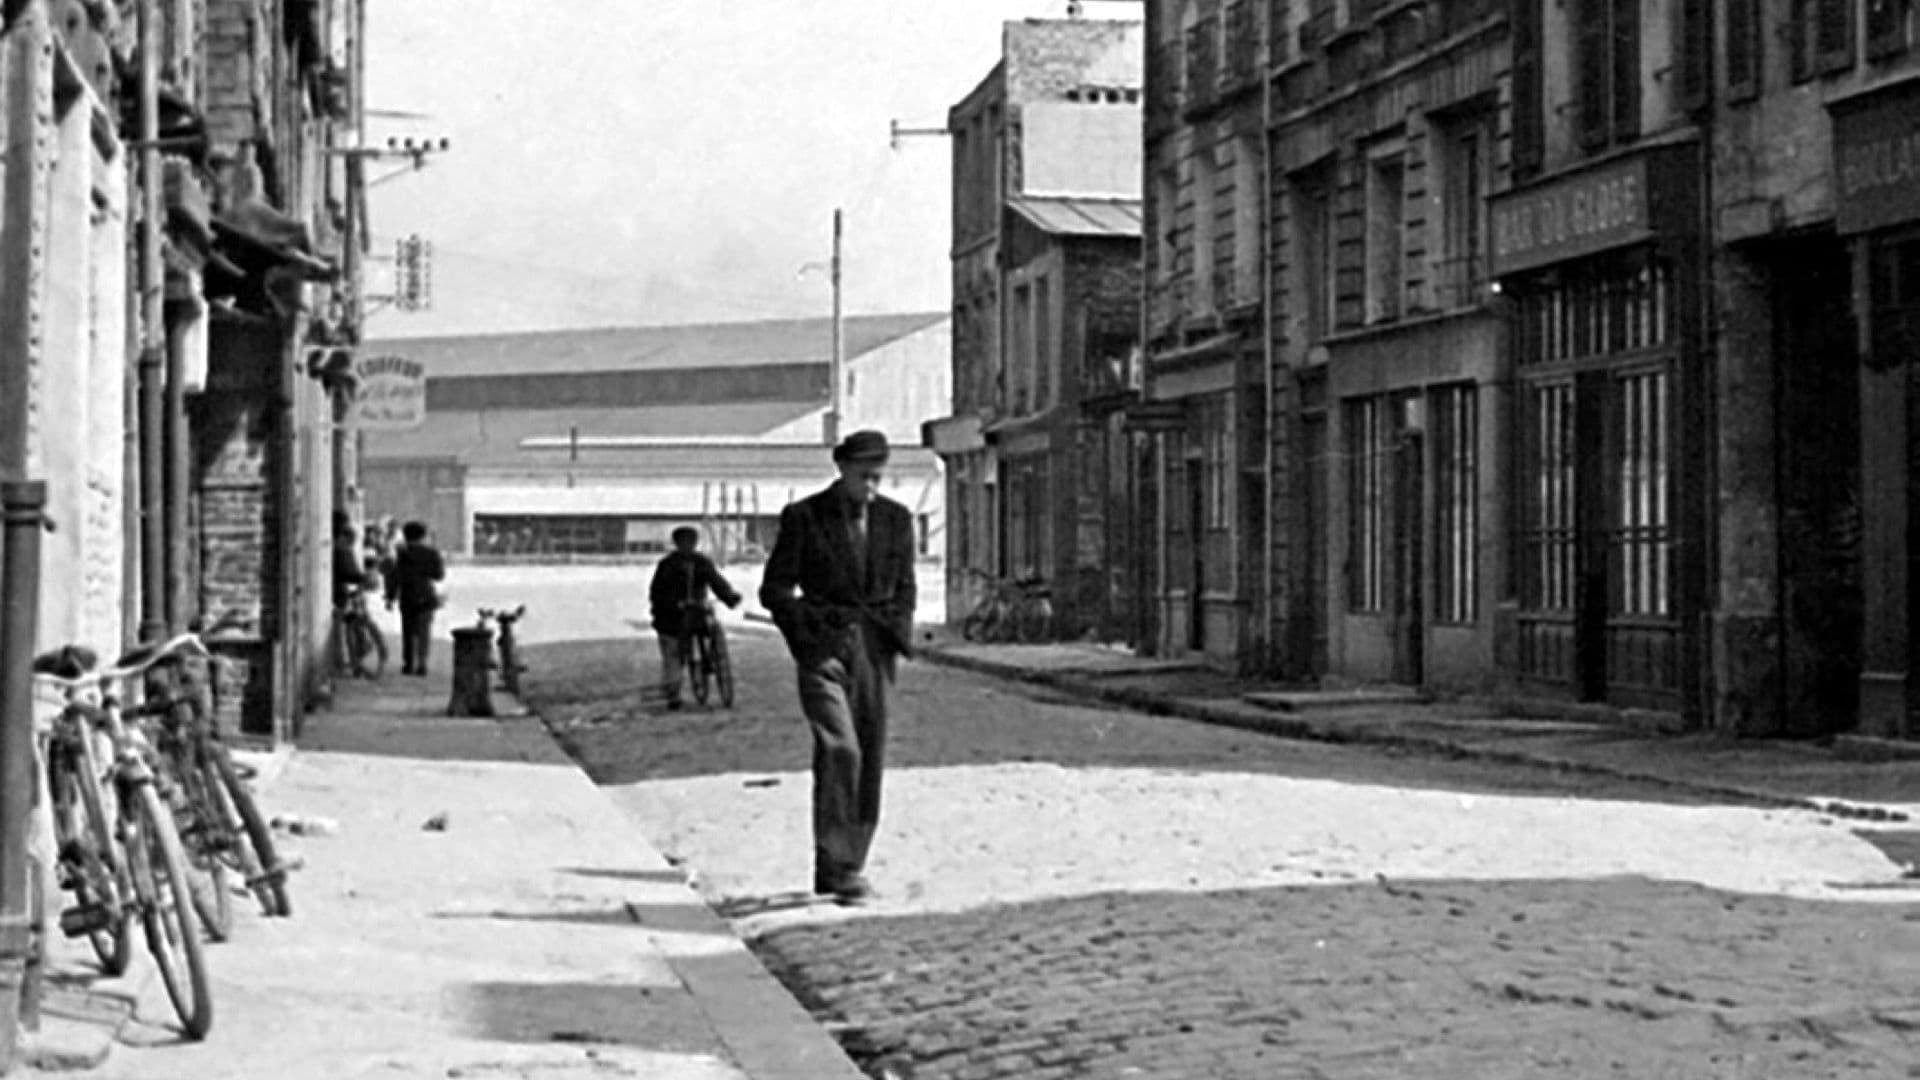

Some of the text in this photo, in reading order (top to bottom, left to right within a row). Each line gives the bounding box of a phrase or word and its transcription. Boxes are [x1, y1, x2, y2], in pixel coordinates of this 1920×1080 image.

[1496, 175, 1637, 255] BAR DU GLOBE
